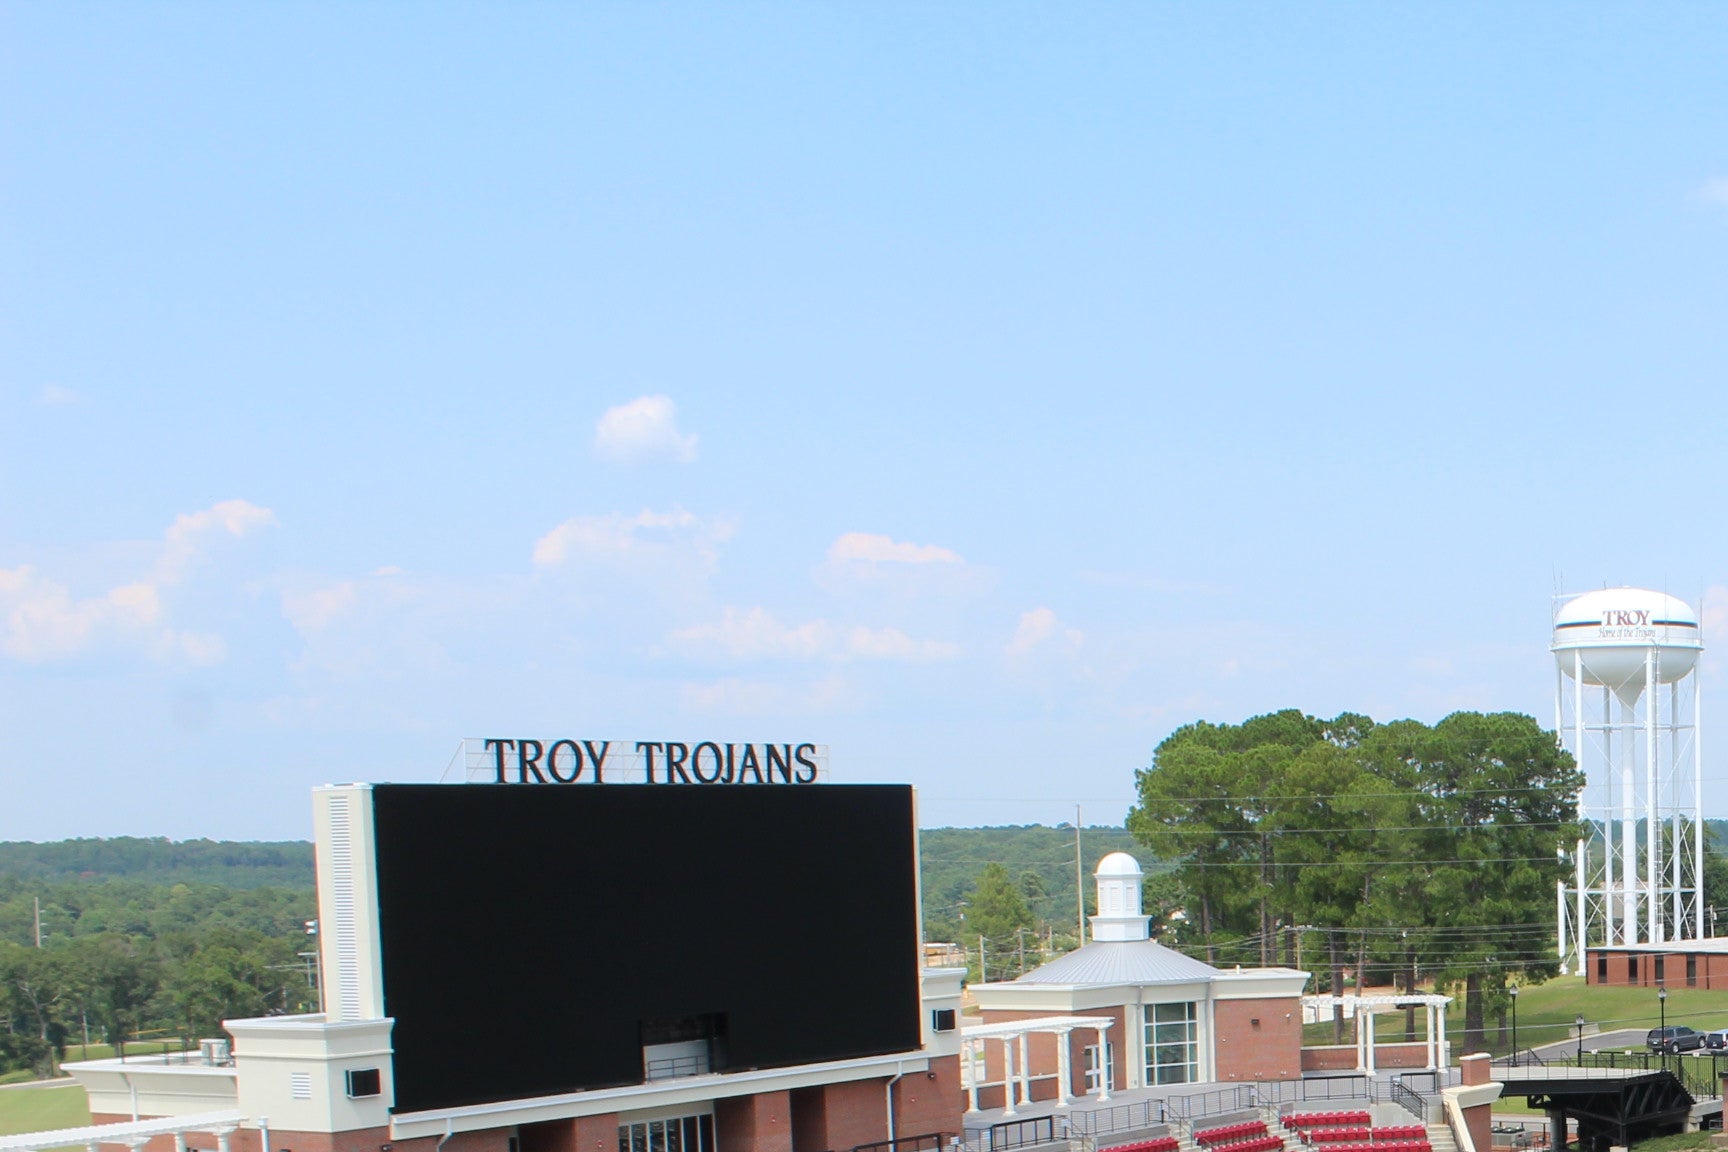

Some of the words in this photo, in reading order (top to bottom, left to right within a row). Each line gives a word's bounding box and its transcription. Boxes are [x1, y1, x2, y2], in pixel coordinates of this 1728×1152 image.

[1602, 610, 1650, 626] TROY
[484, 738, 610, 784] TROY
[635, 740, 819, 784] TROJANS
